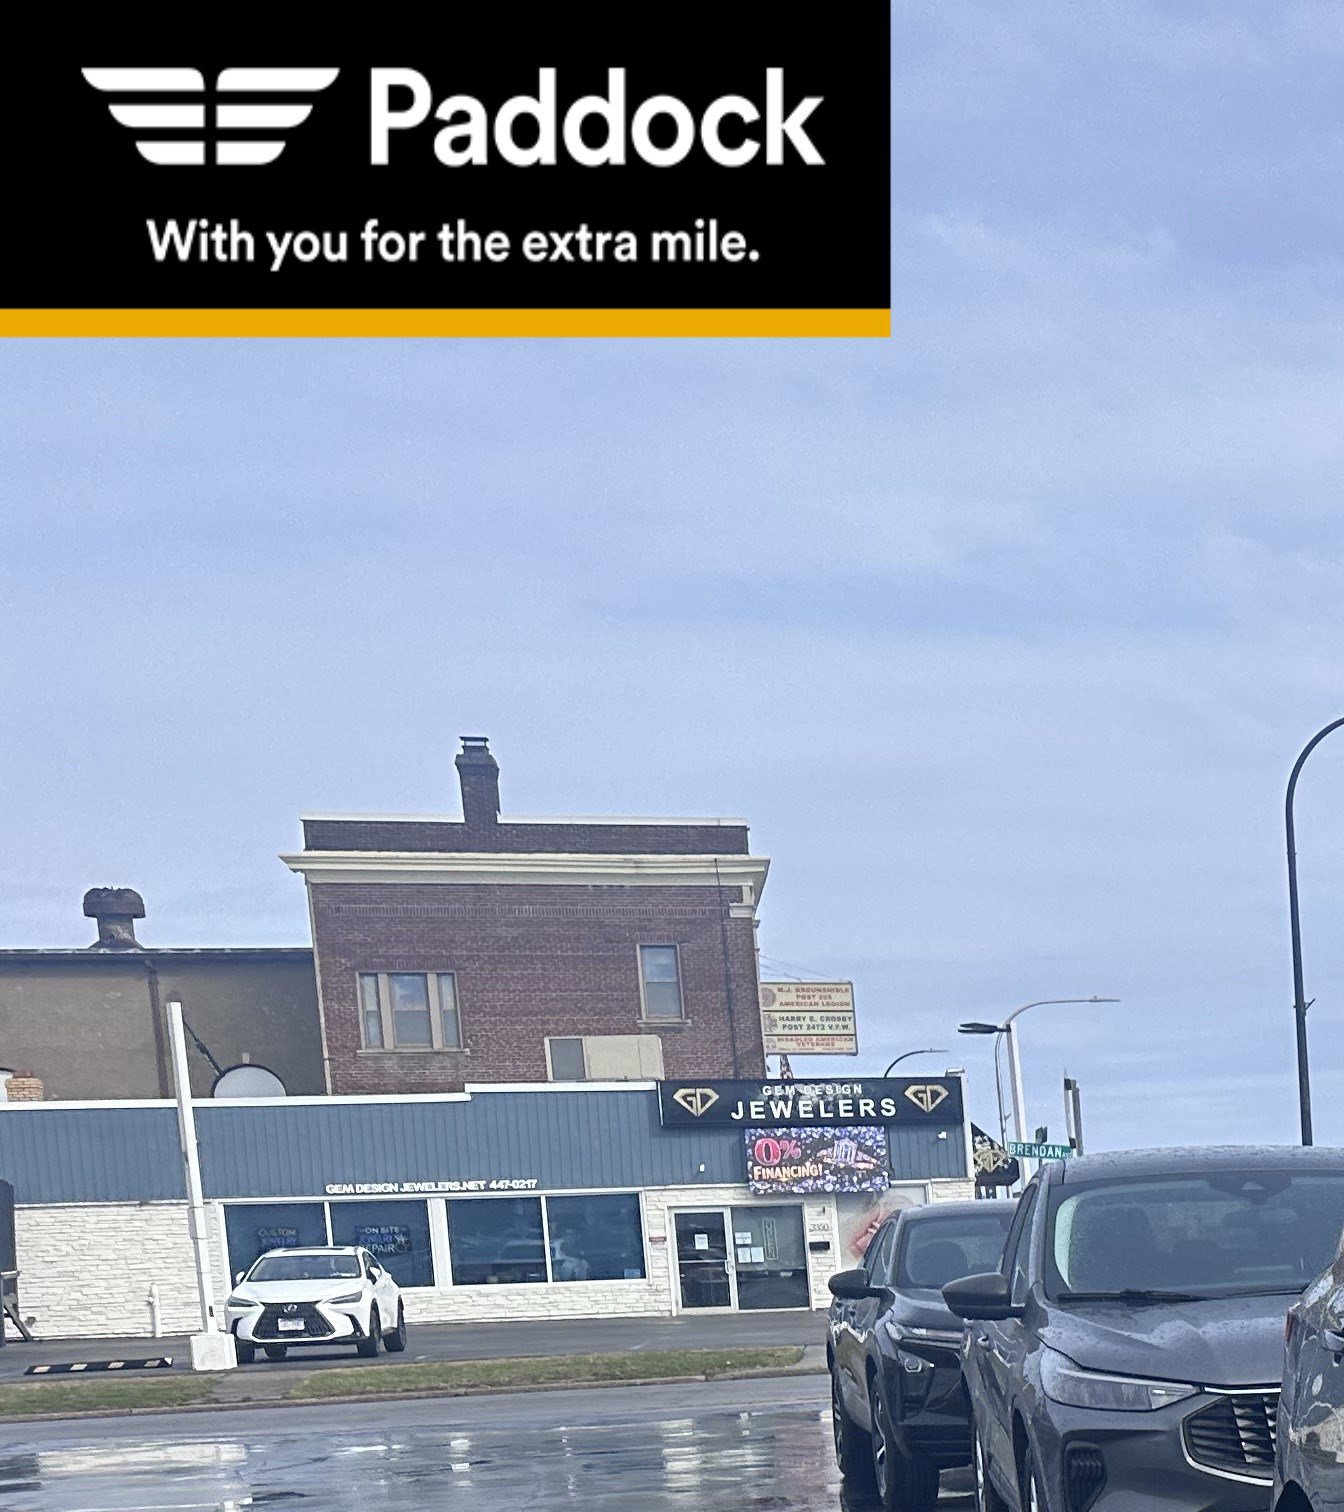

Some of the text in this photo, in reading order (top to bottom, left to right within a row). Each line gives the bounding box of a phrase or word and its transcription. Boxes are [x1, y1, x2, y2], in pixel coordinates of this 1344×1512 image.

[762, 1084, 863, 1096] GEM DESIGN
[731, 1098, 897, 1120] JEWELERS
[1009, 1143, 1062, 1159] BRENDAN
[753, 1162, 824, 1182] FINANCING!
[325, 1183, 354, 1195] GEM
[355, 1182, 398, 1194] DESIGN
